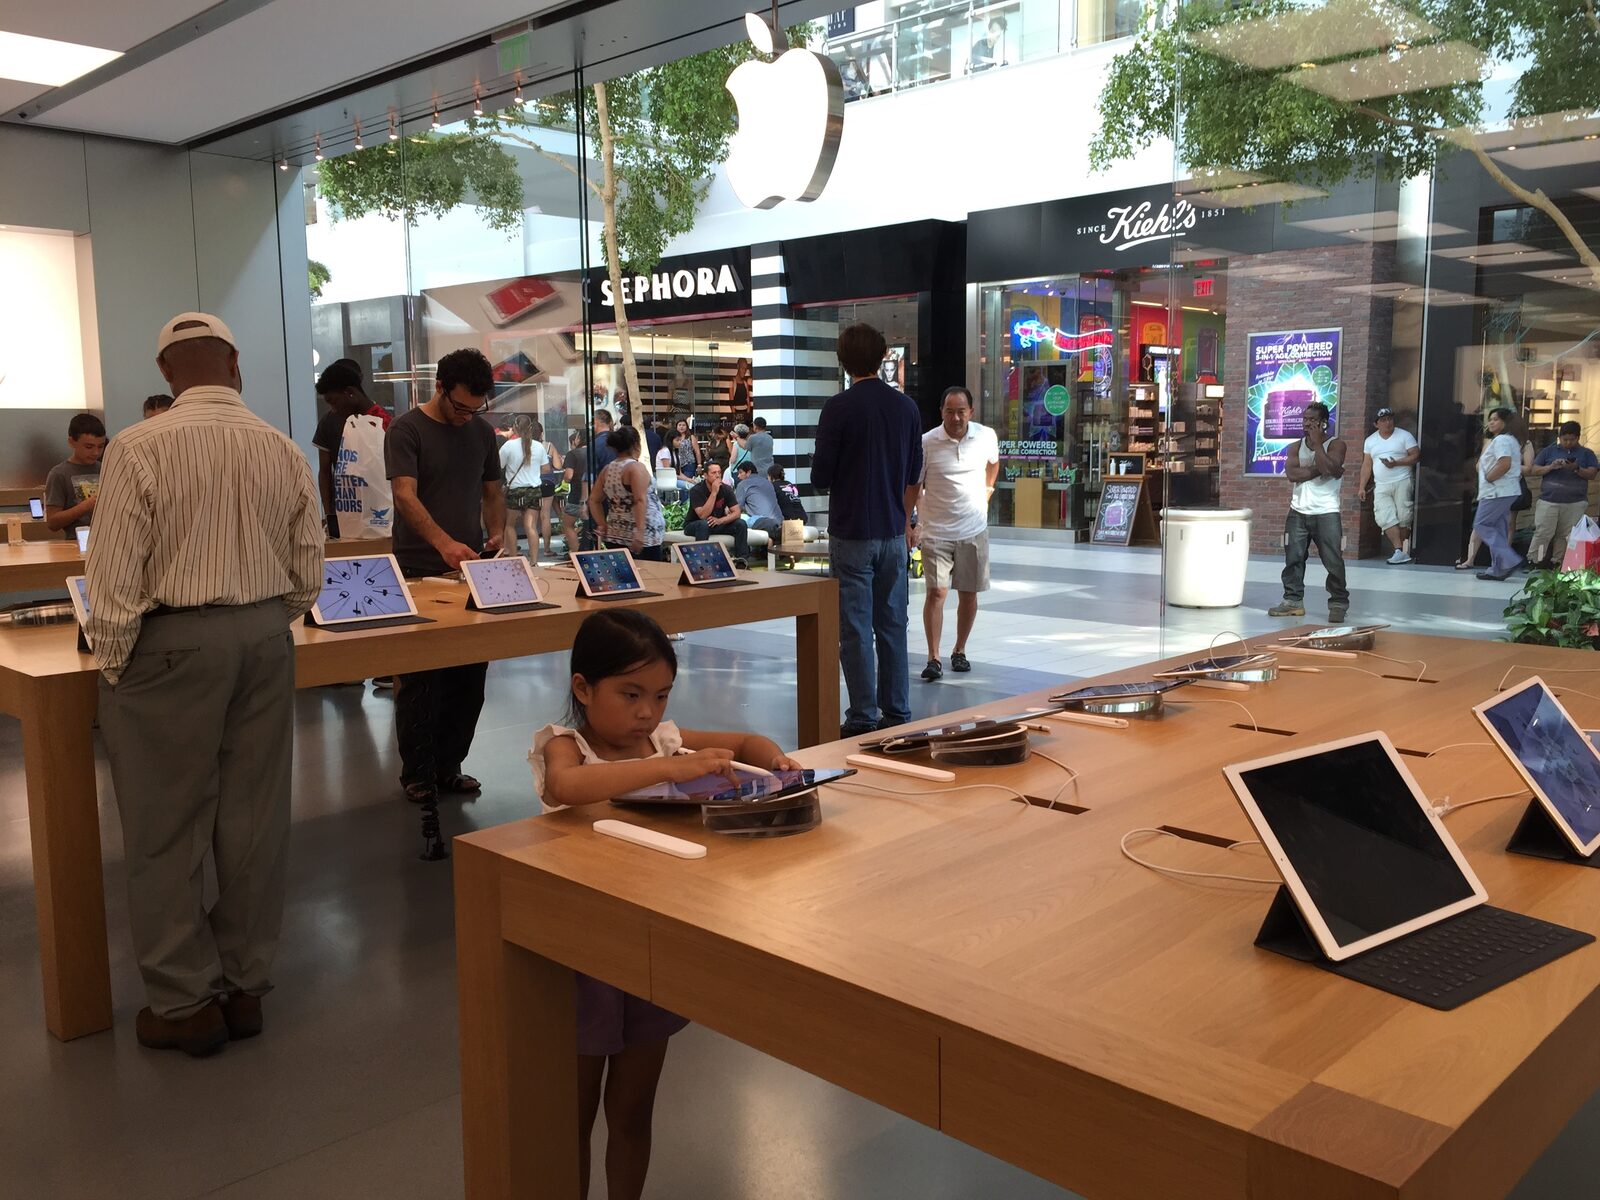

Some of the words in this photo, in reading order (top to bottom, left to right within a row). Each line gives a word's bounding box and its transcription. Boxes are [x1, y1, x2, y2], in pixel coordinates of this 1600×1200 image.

[1076, 224, 1106, 235] SINCE
[1099, 199, 1196, 251] Kiehl's
[1201, 208, 1226, 219] 1851
[600, 264, 737, 307] SEPHORA
[1196, 280, 1212, 296] EXIT
[1256, 345, 1284, 354] SUPER
[1287, 342, 1333, 351] POWERED
[1290, 350, 1332, 359] CORRECTION
[1020, 448, 1057, 456] CORRECTION
[335, 462, 348, 474] RE
[335, 475, 368, 487] ETTER
[335, 488, 356, 499] HAN
[336, 500, 362, 512] OURS
